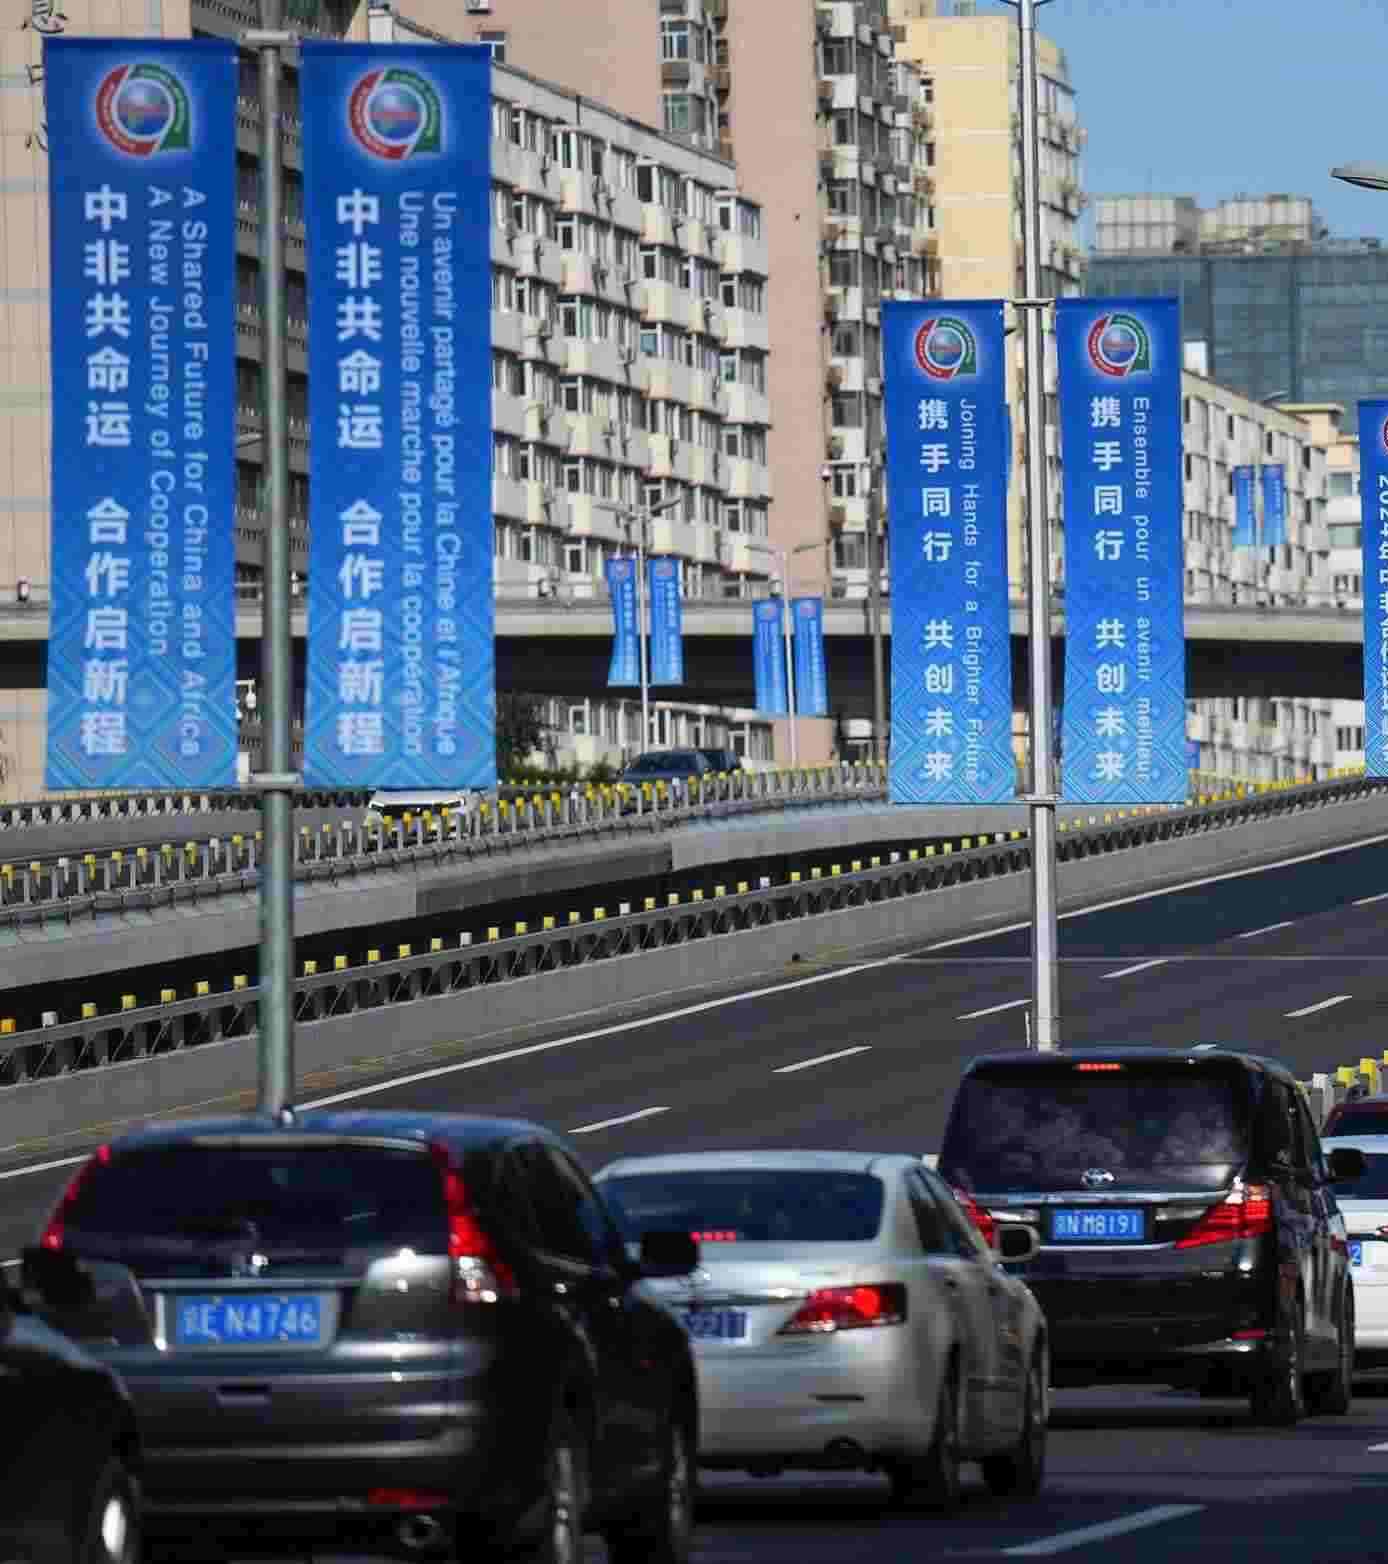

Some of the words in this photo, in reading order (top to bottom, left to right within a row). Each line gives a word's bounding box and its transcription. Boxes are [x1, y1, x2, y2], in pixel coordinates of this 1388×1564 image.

[148, 186, 174, 207] A
[184, 186, 208, 207] A
[148, 220, 174, 286] New
[184, 221, 208, 328] Shared
[84, 184, 131, 448] 中非共命运
[144, 296, 175, 417] Journey
[336, 189, 384, 448] 中非共命运
[184, 342, 208, 441] Future
[958, 399, 977, 471] Joining
[151, 430, 177, 463] of
[184, 449, 208, 494] for
[918, 398, 953, 561] 携手同行
[1090, 396, 1126, 562] 携手同行
[1132, 396, 1151, 498] Ensemble
[182, 504, 207, 592] China
[962, 484, 982, 546] Hands
[1131, 515, 1150, 561] pour
[145, 470, 176, 656] Cooperation
[962, 559, 983, 587] for
[965, 600, 979, 613] a
[1135, 576, 1151, 601] un
[80, 497, 130, 757] 合作启新程
[181, 606, 207, 657] and
[336, 500, 384, 756] 合作启新程
[961, 625, 983, 705] Brighter
[1135, 616, 1153, 682] avenir
[180, 670, 206, 757] Africa
[922, 619, 954, 784] 共创未来
[1095, 618, 1128, 784] 共创未来
[1135, 697, 1153, 785] meilleur
[965, 719, 983, 784] Future
